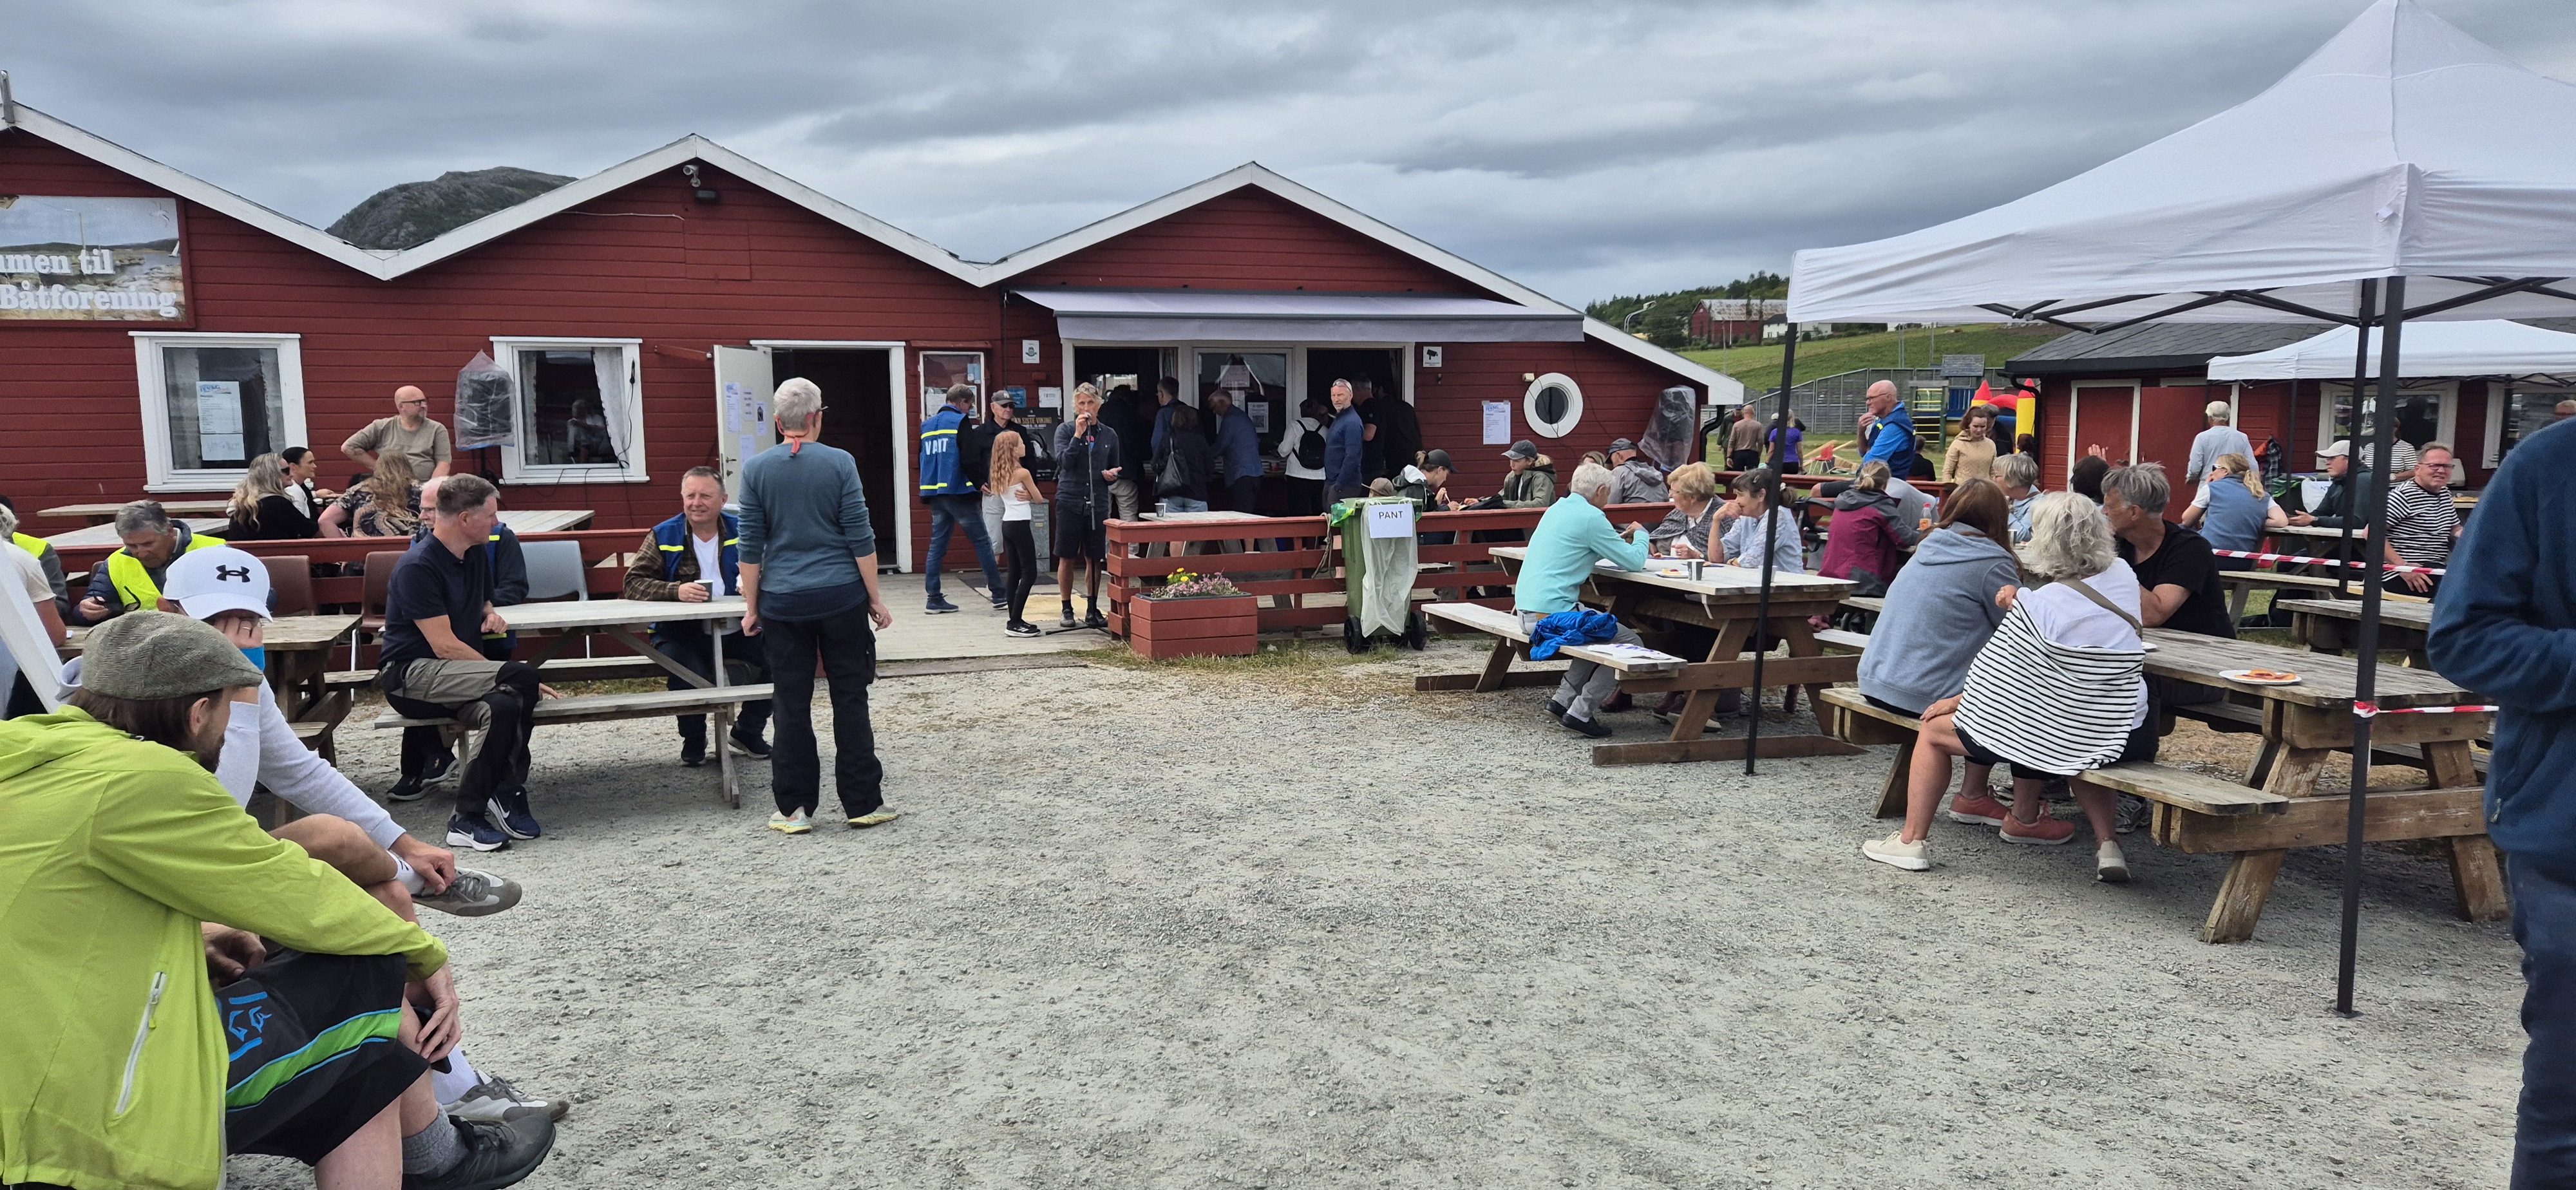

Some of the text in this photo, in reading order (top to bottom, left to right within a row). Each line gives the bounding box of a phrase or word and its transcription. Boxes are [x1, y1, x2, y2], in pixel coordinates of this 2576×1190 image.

[0, 249, 115, 274] men til
[0, 280, 178, 317] Båtforening
[1378, 511, 1403, 520] PANT
